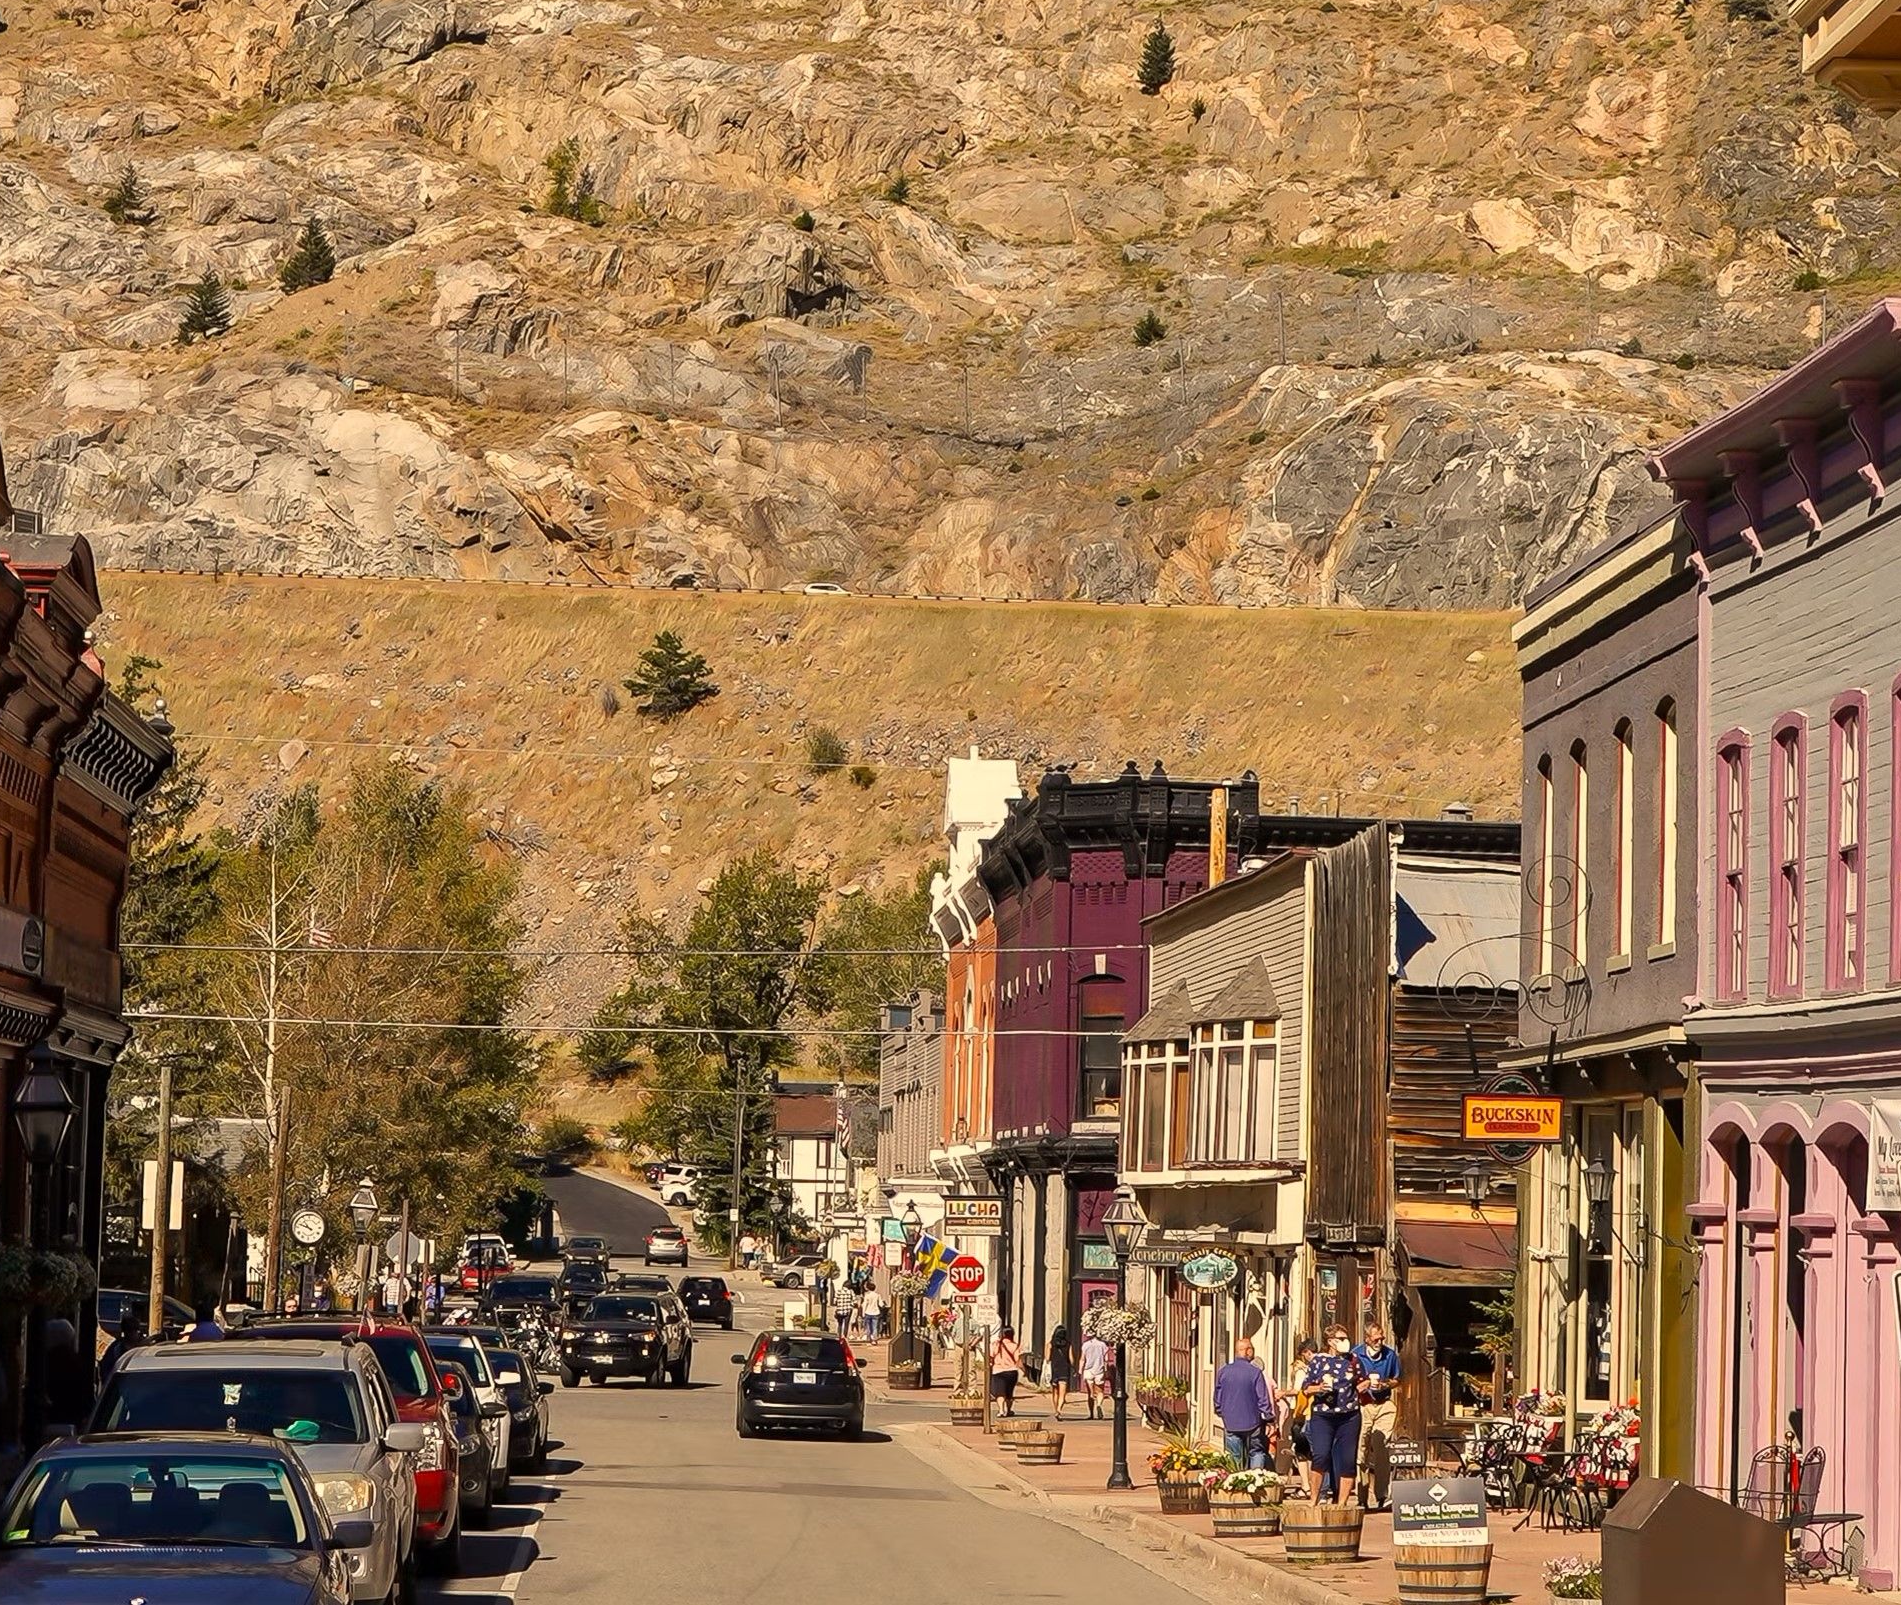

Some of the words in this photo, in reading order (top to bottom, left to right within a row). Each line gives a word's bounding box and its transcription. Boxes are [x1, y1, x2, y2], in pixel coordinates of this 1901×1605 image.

[1471, 1106, 1554, 1124] BUCKSKIN
[949, 1202, 999, 1216] LUCHA
[951, 1267, 984, 1282] STOP
[1389, 1454, 1421, 1464] OPEN
[1441, 1502, 1479, 1514] Company
